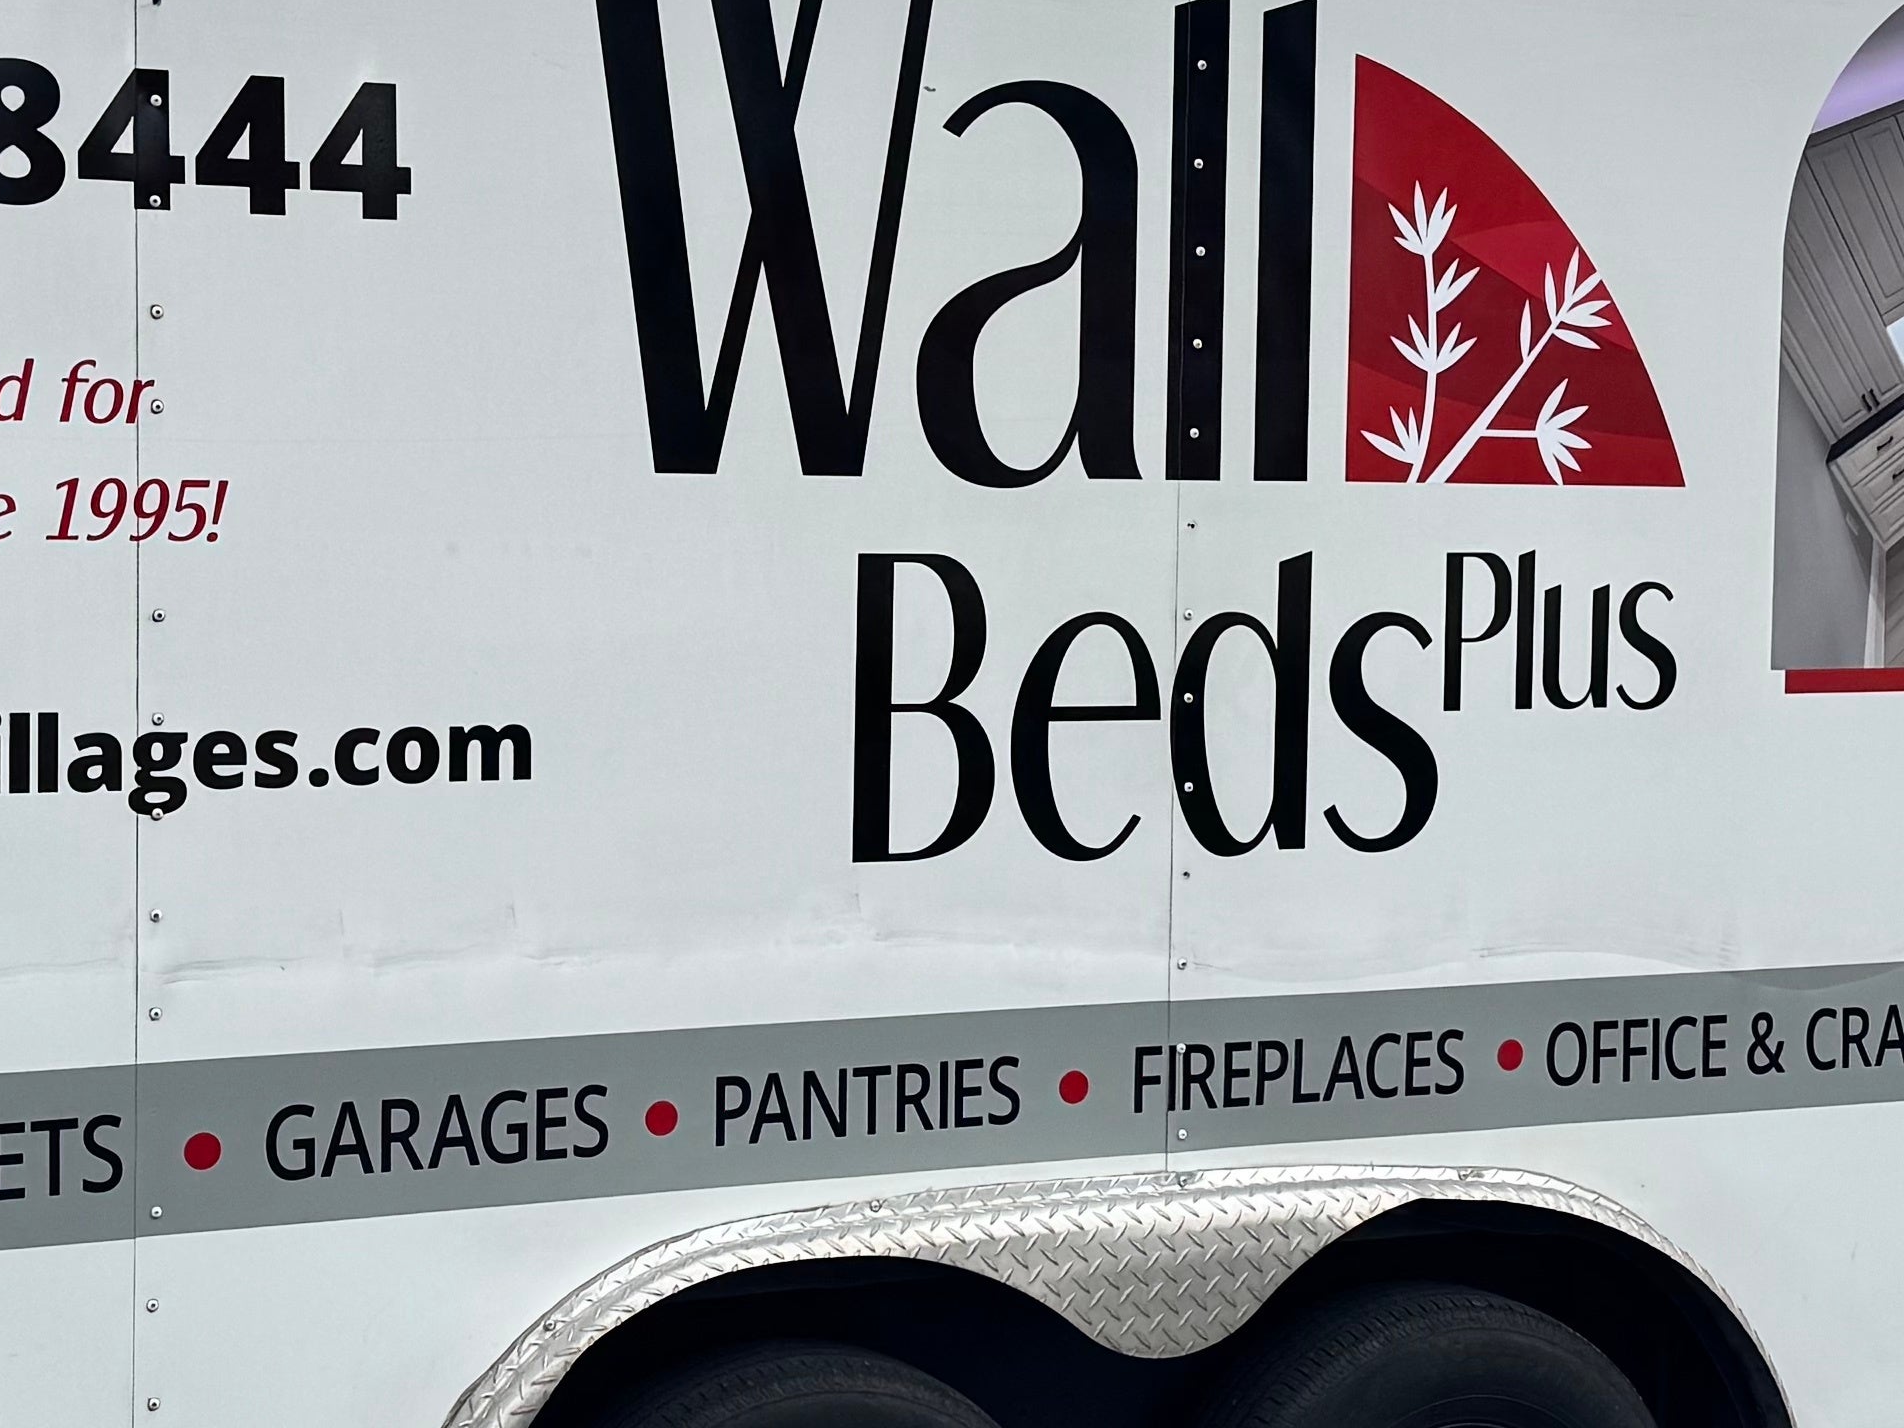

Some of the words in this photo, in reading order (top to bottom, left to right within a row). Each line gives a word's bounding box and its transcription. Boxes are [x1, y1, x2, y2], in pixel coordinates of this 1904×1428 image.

[59, 362, 152, 425] for
[50, 478, 230, 543] 1995!
[852, 551, 1439, 862] Beds
[1443, 550, 1677, 711] Plus
[265, 1084, 609, 1181] GARAGES
[715, 1055, 1020, 1147] PANTRIES
[1133, 1028, 1465, 1114] FIREPLACES
[1546, 1014, 1728, 1087] OFFICE
[1746, 1011, 1786, 1075] &
